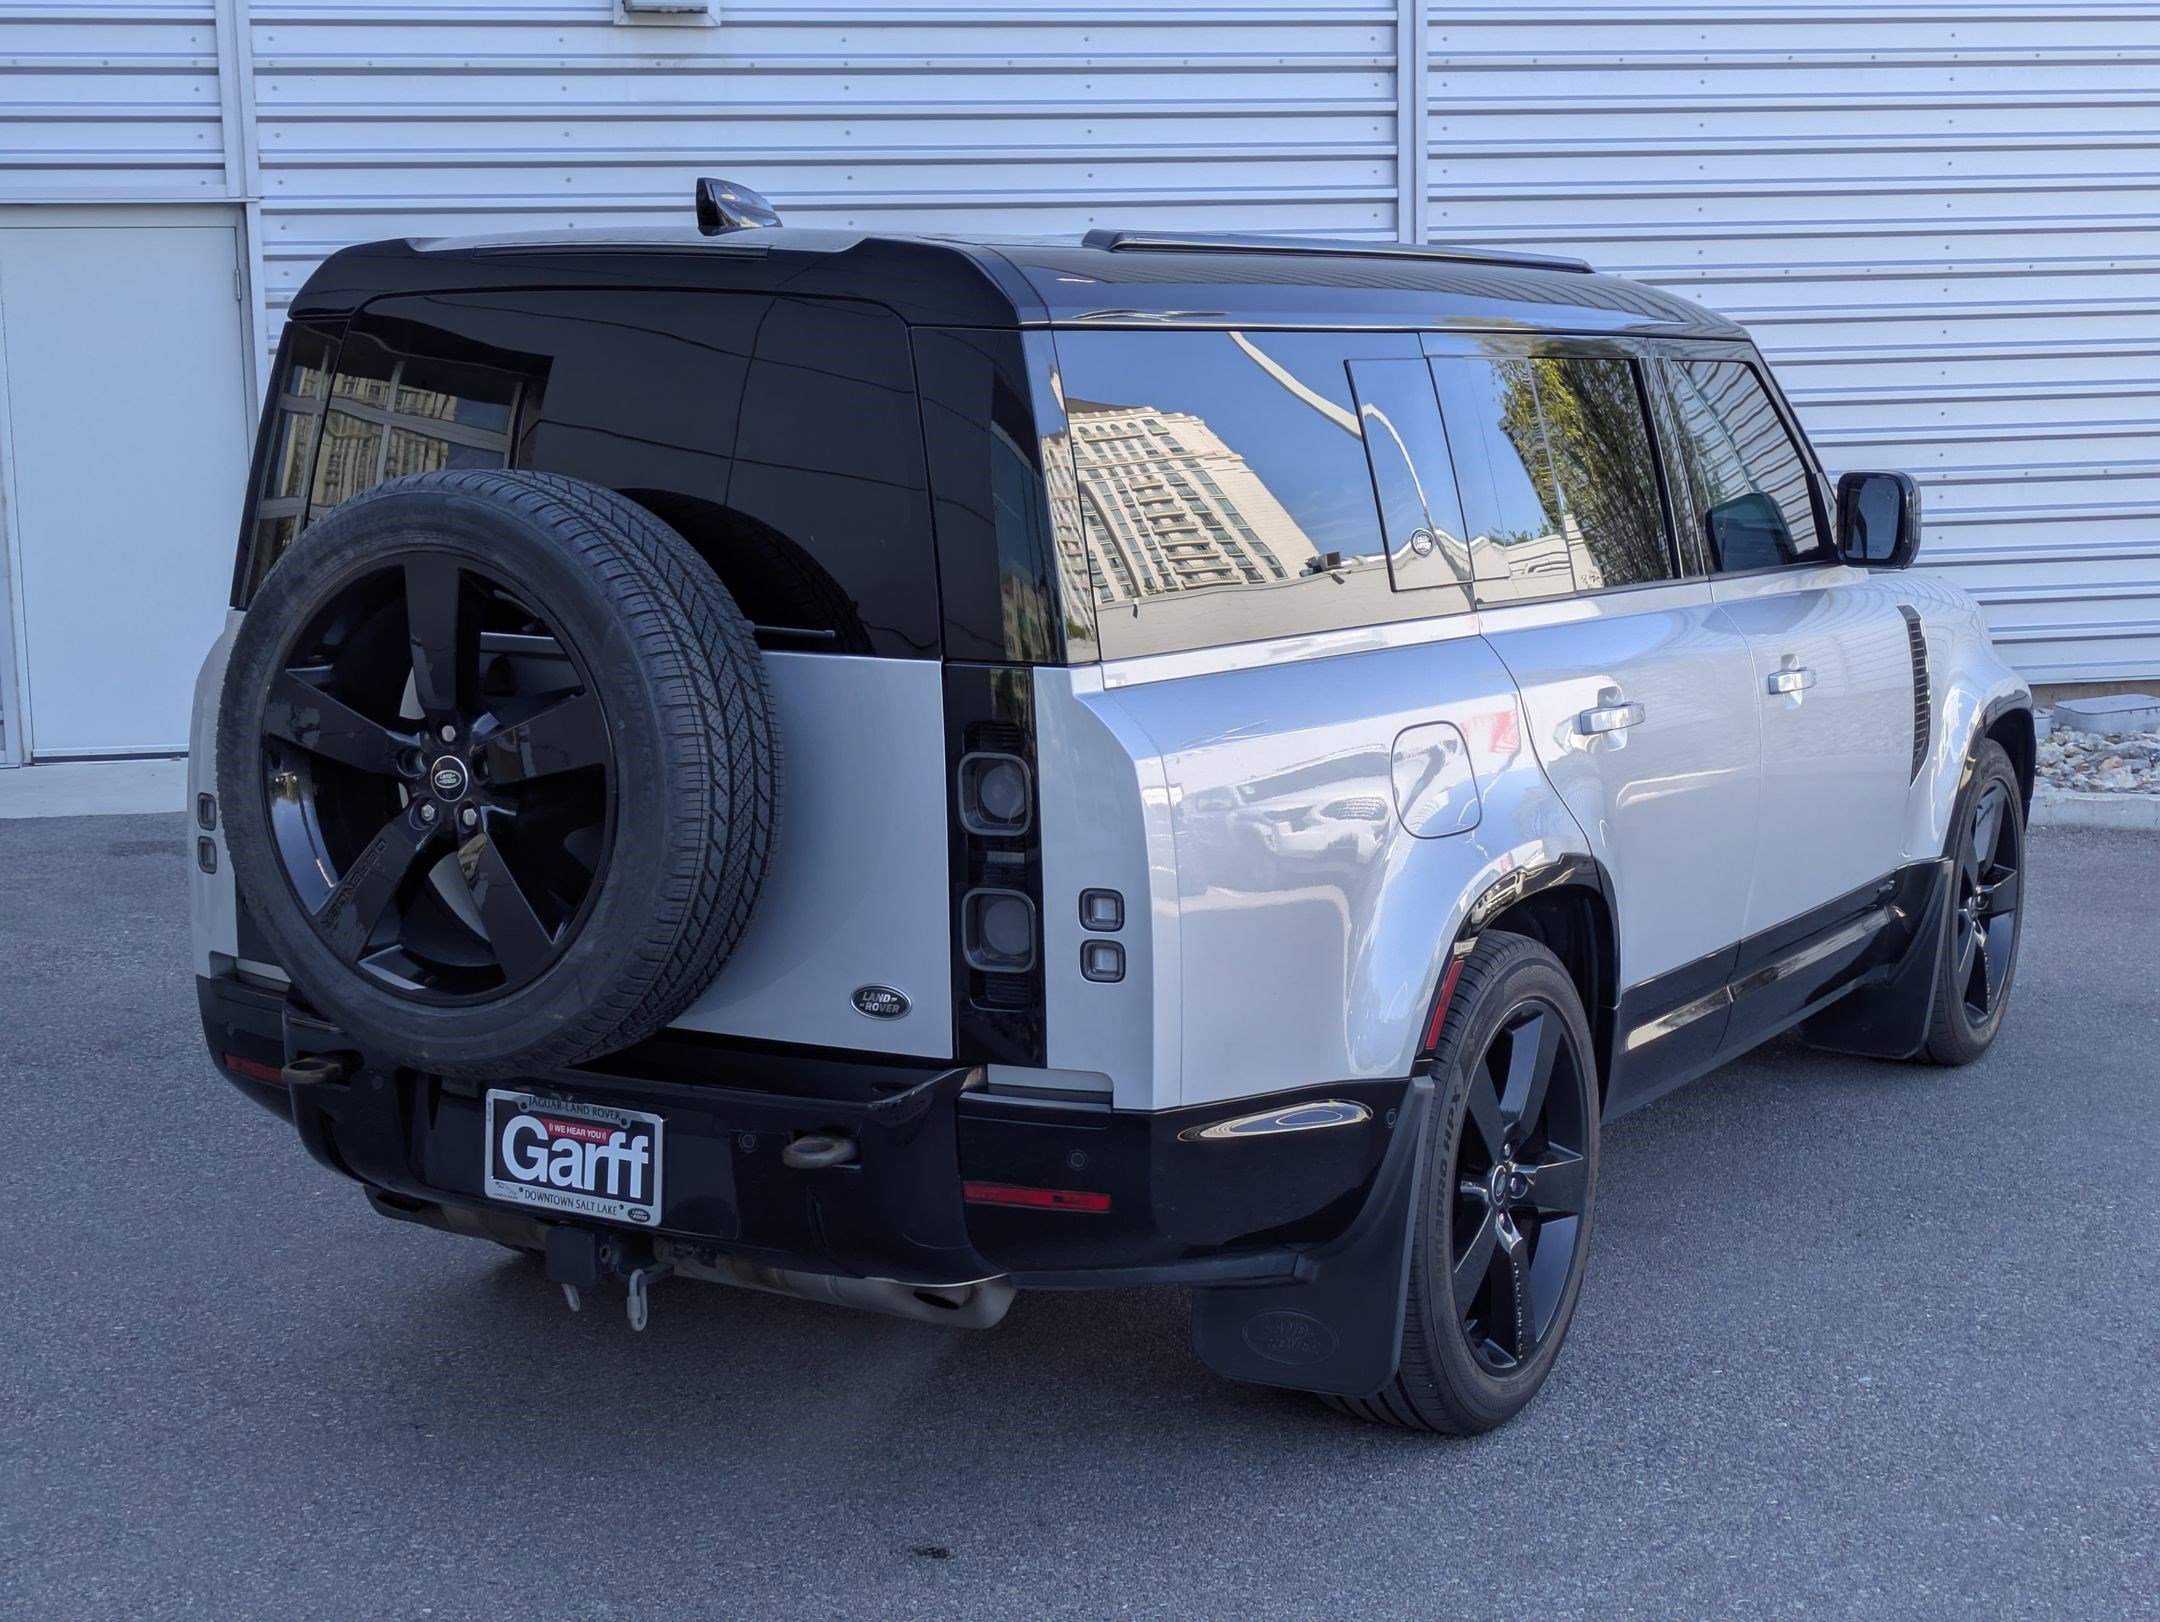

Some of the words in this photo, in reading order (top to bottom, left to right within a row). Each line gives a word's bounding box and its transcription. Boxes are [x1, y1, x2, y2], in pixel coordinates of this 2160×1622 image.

[862, 991, 891, 1003] LAND
[864, 1002, 900, 1014] ROVER
[566, 1101, 590, 1114] LAND
[592, 1107, 621, 1120] ROVER
[554, 1123, 566, 1133] WE
[566, 1125, 586, 1137] HEAR
[586, 1129, 602, 1139] YOU
[502, 1115, 649, 1199] Garff
[524, 1189, 574, 1208] DOWNTOWN
[576, 1199, 596, 1212] SALT
[597, 1203, 617, 1216] LAKE
